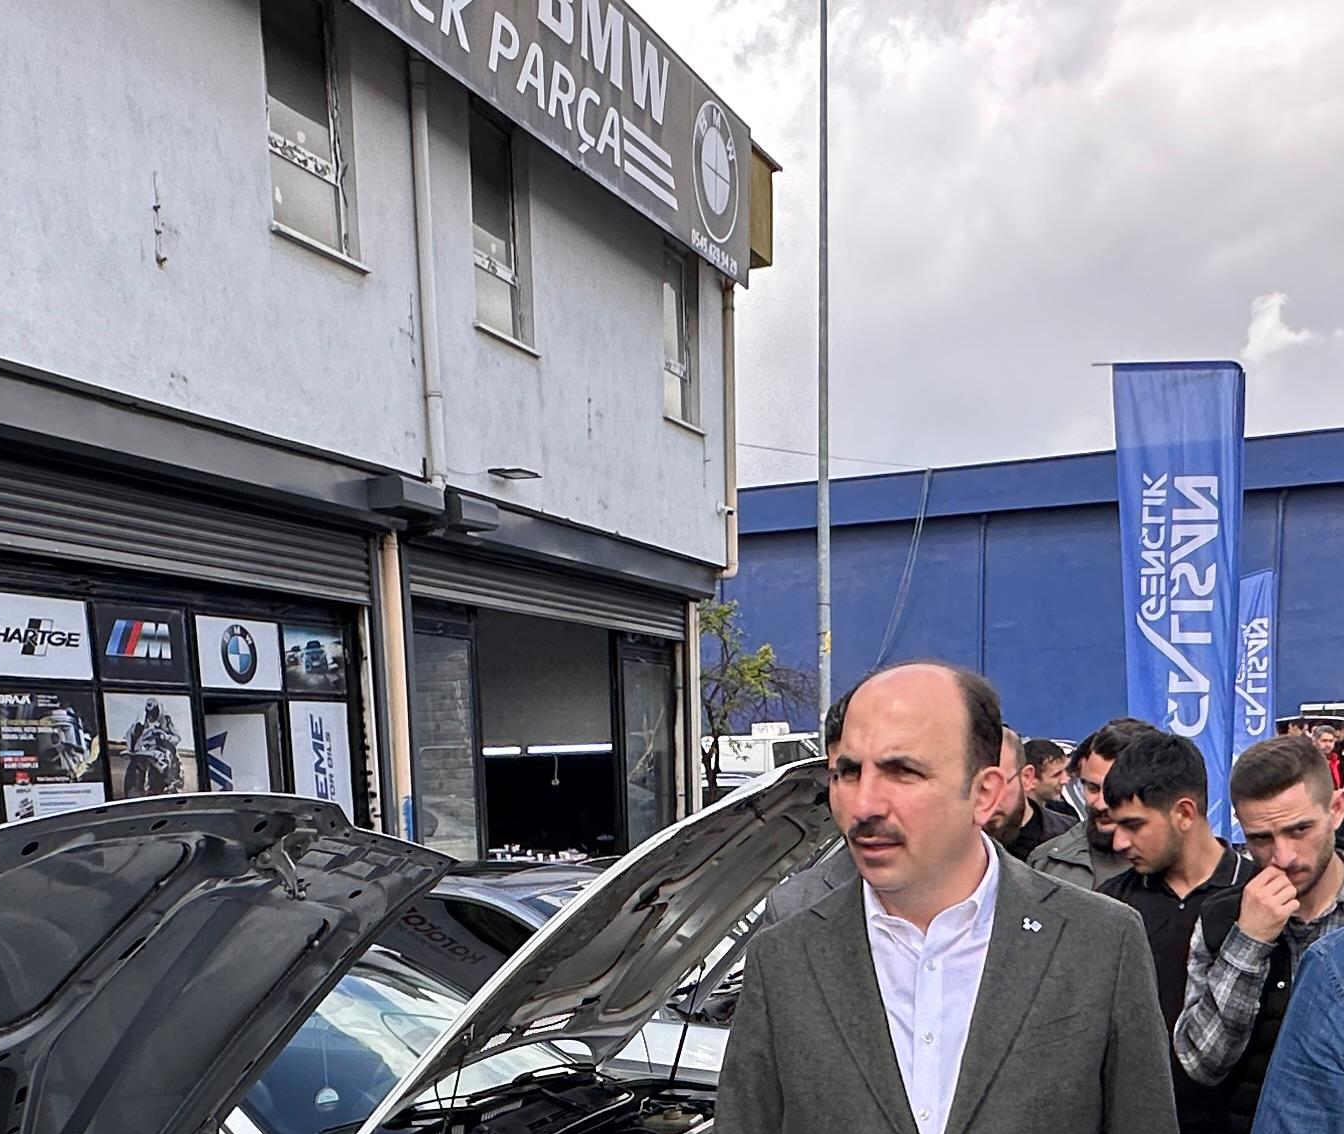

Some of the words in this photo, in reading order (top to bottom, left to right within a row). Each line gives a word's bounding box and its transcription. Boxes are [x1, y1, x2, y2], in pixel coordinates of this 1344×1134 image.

[488, 11, 622, 168] PARÇA
[538, 0, 670, 126] BMW
[324, 731, 334, 769] OILS
